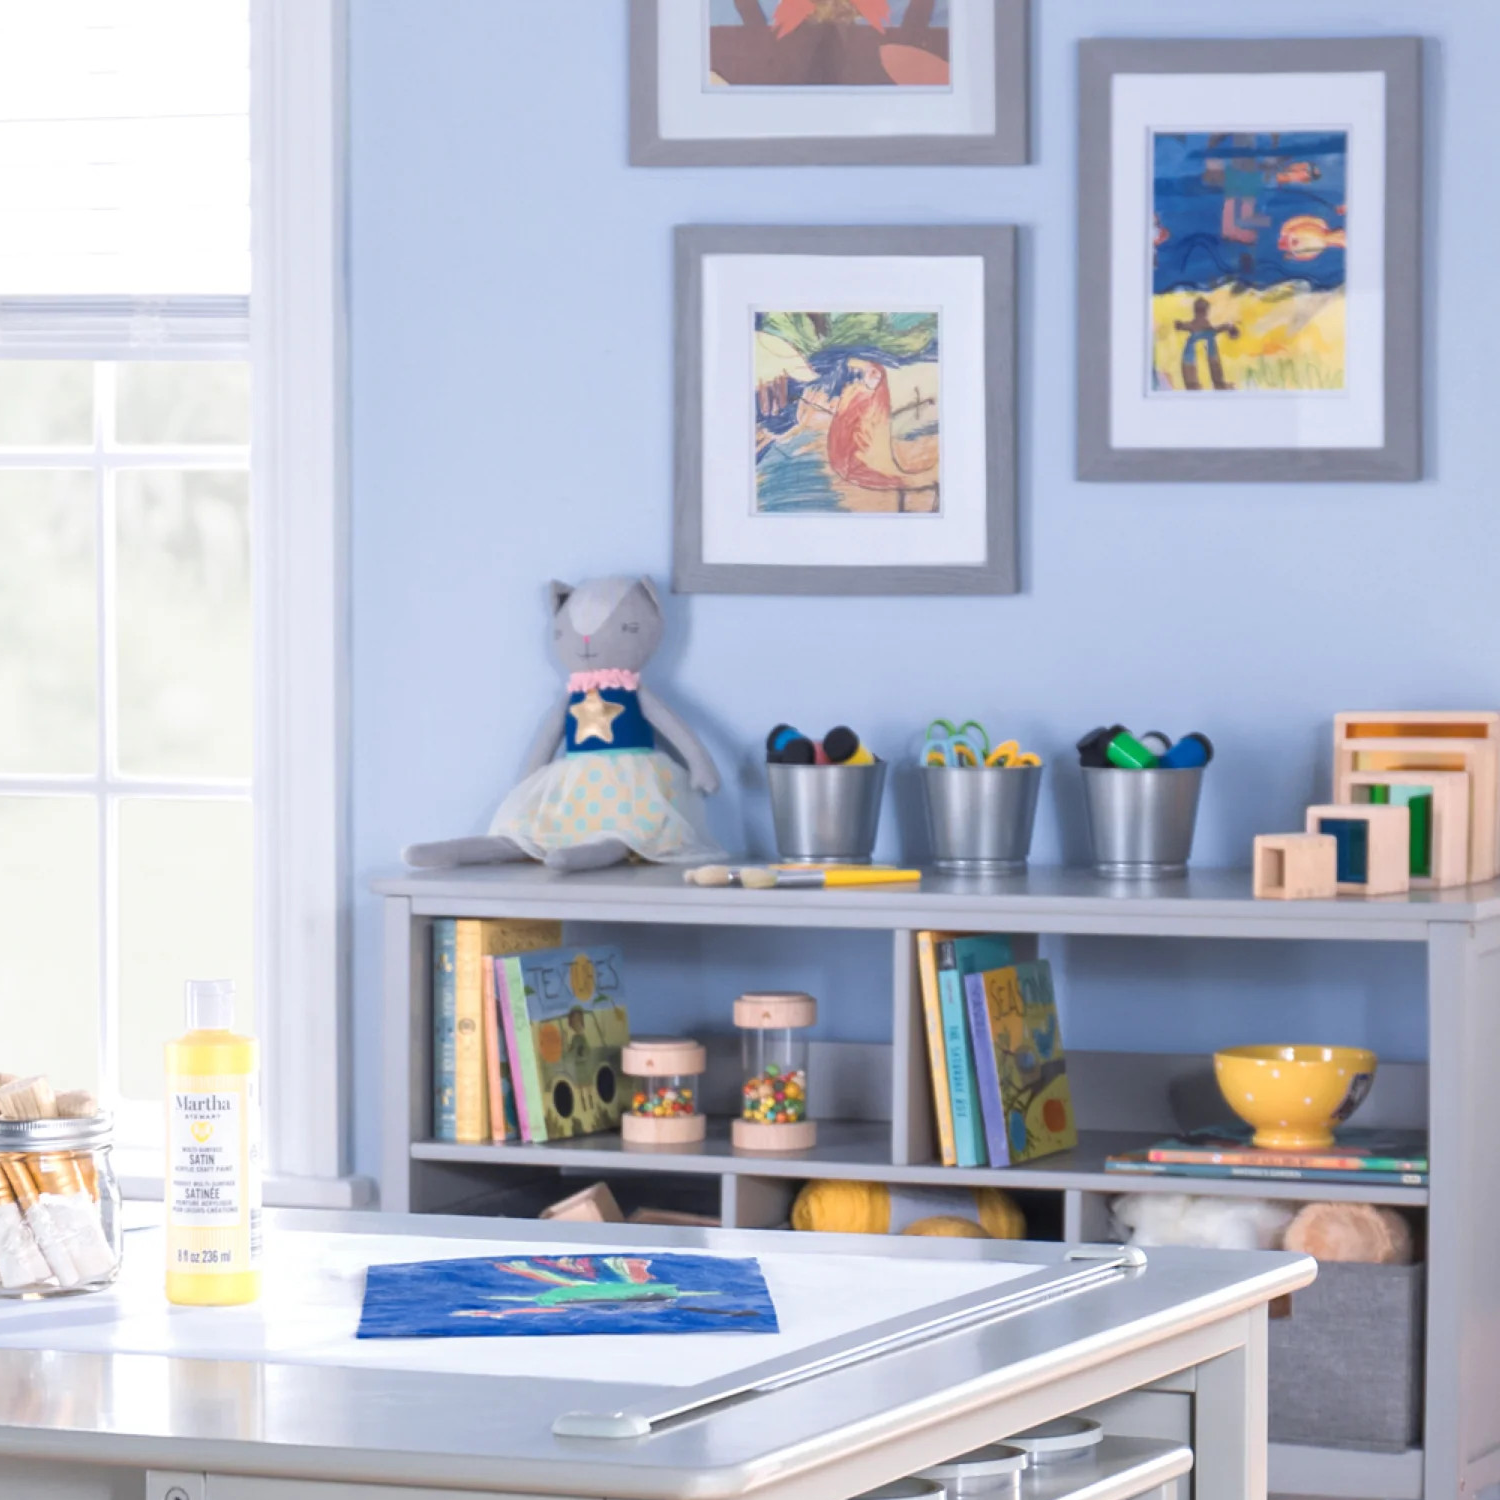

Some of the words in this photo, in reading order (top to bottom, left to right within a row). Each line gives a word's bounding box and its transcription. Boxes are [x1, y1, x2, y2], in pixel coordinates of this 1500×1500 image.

[176, 1094, 231, 1111] Martha
[189, 1154, 215, 1164] SATIN
[185, 1186, 220, 1199] SATINÉE
[177, 1249, 182, 1262] 8
[183, 1249, 189, 1262] fl
[190, 1252, 200, 1263] oz
[202, 1250, 218, 1263] 236
[220, 1249, 231, 1262] ml
